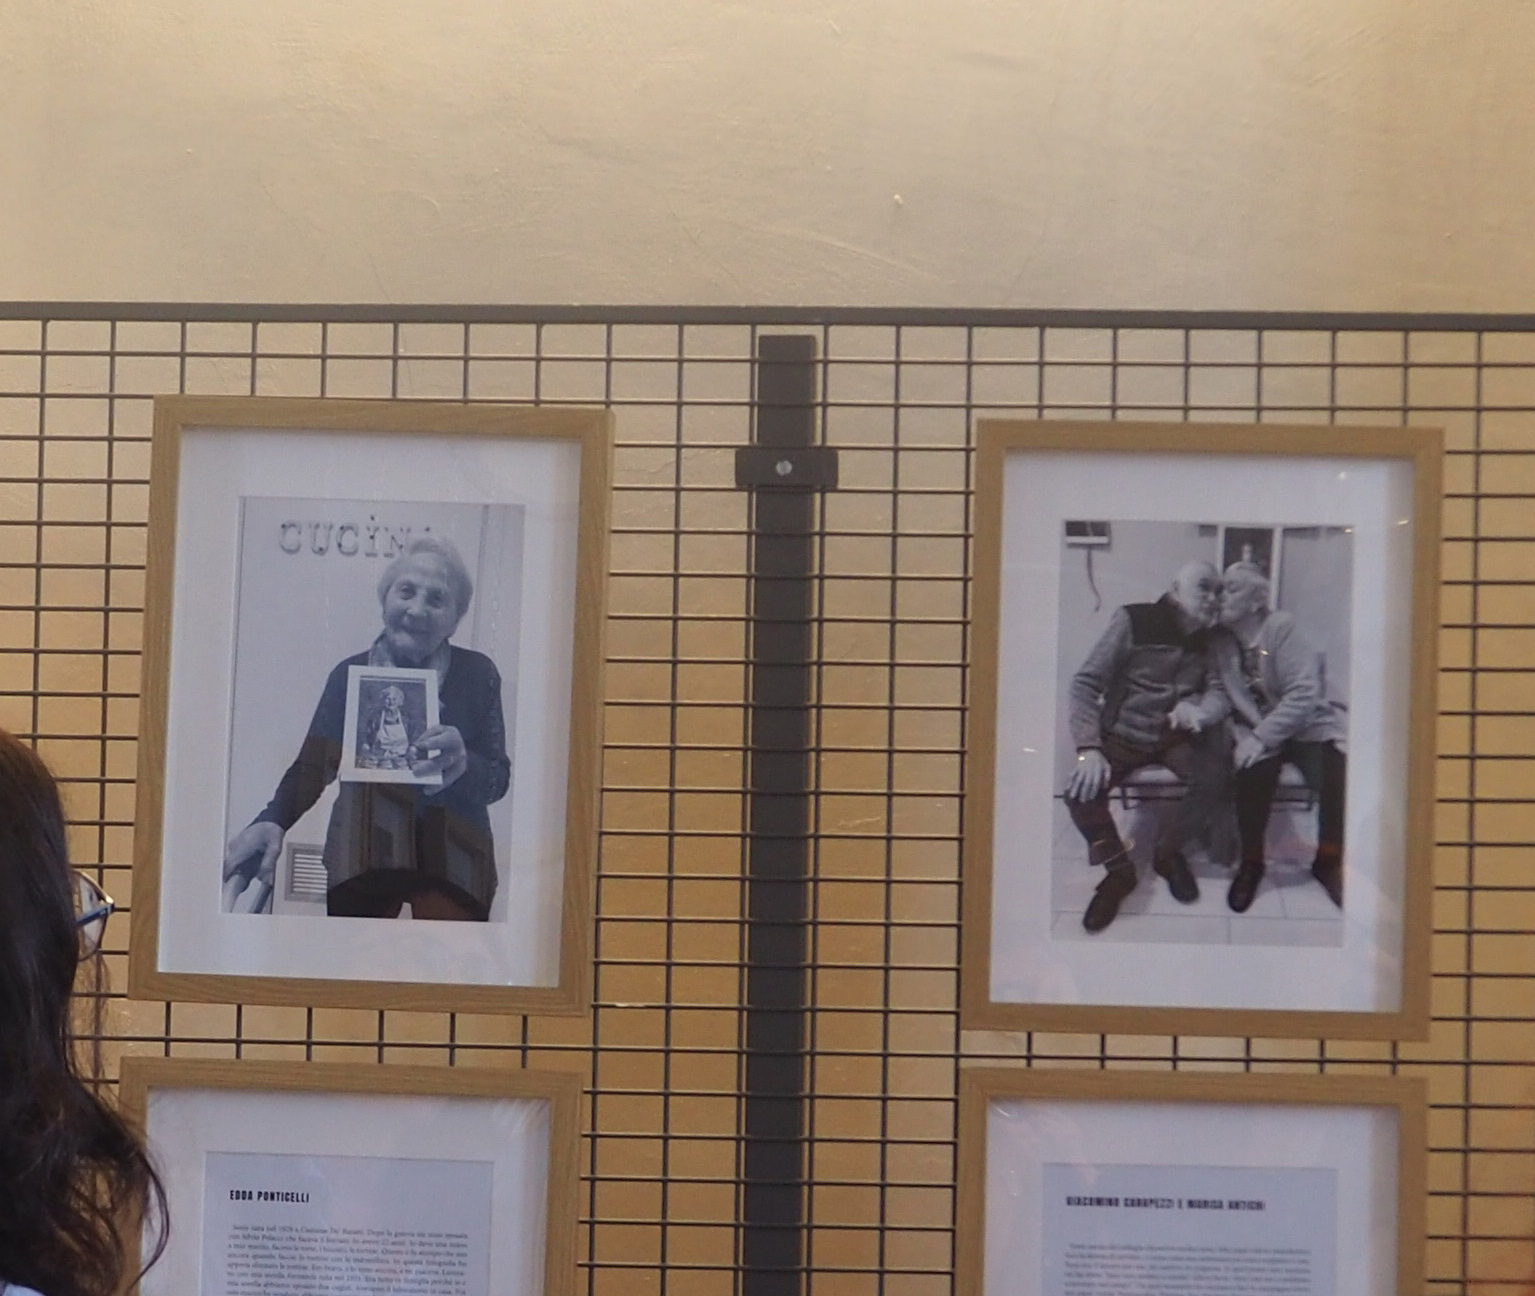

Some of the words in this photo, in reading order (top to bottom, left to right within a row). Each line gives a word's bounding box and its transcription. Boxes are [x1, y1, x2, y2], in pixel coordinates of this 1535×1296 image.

[279, 514, 430, 557] CUCIN
[229, 1189, 253, 1201] EDDA
[257, 1190, 310, 1204] PONTICELLI
